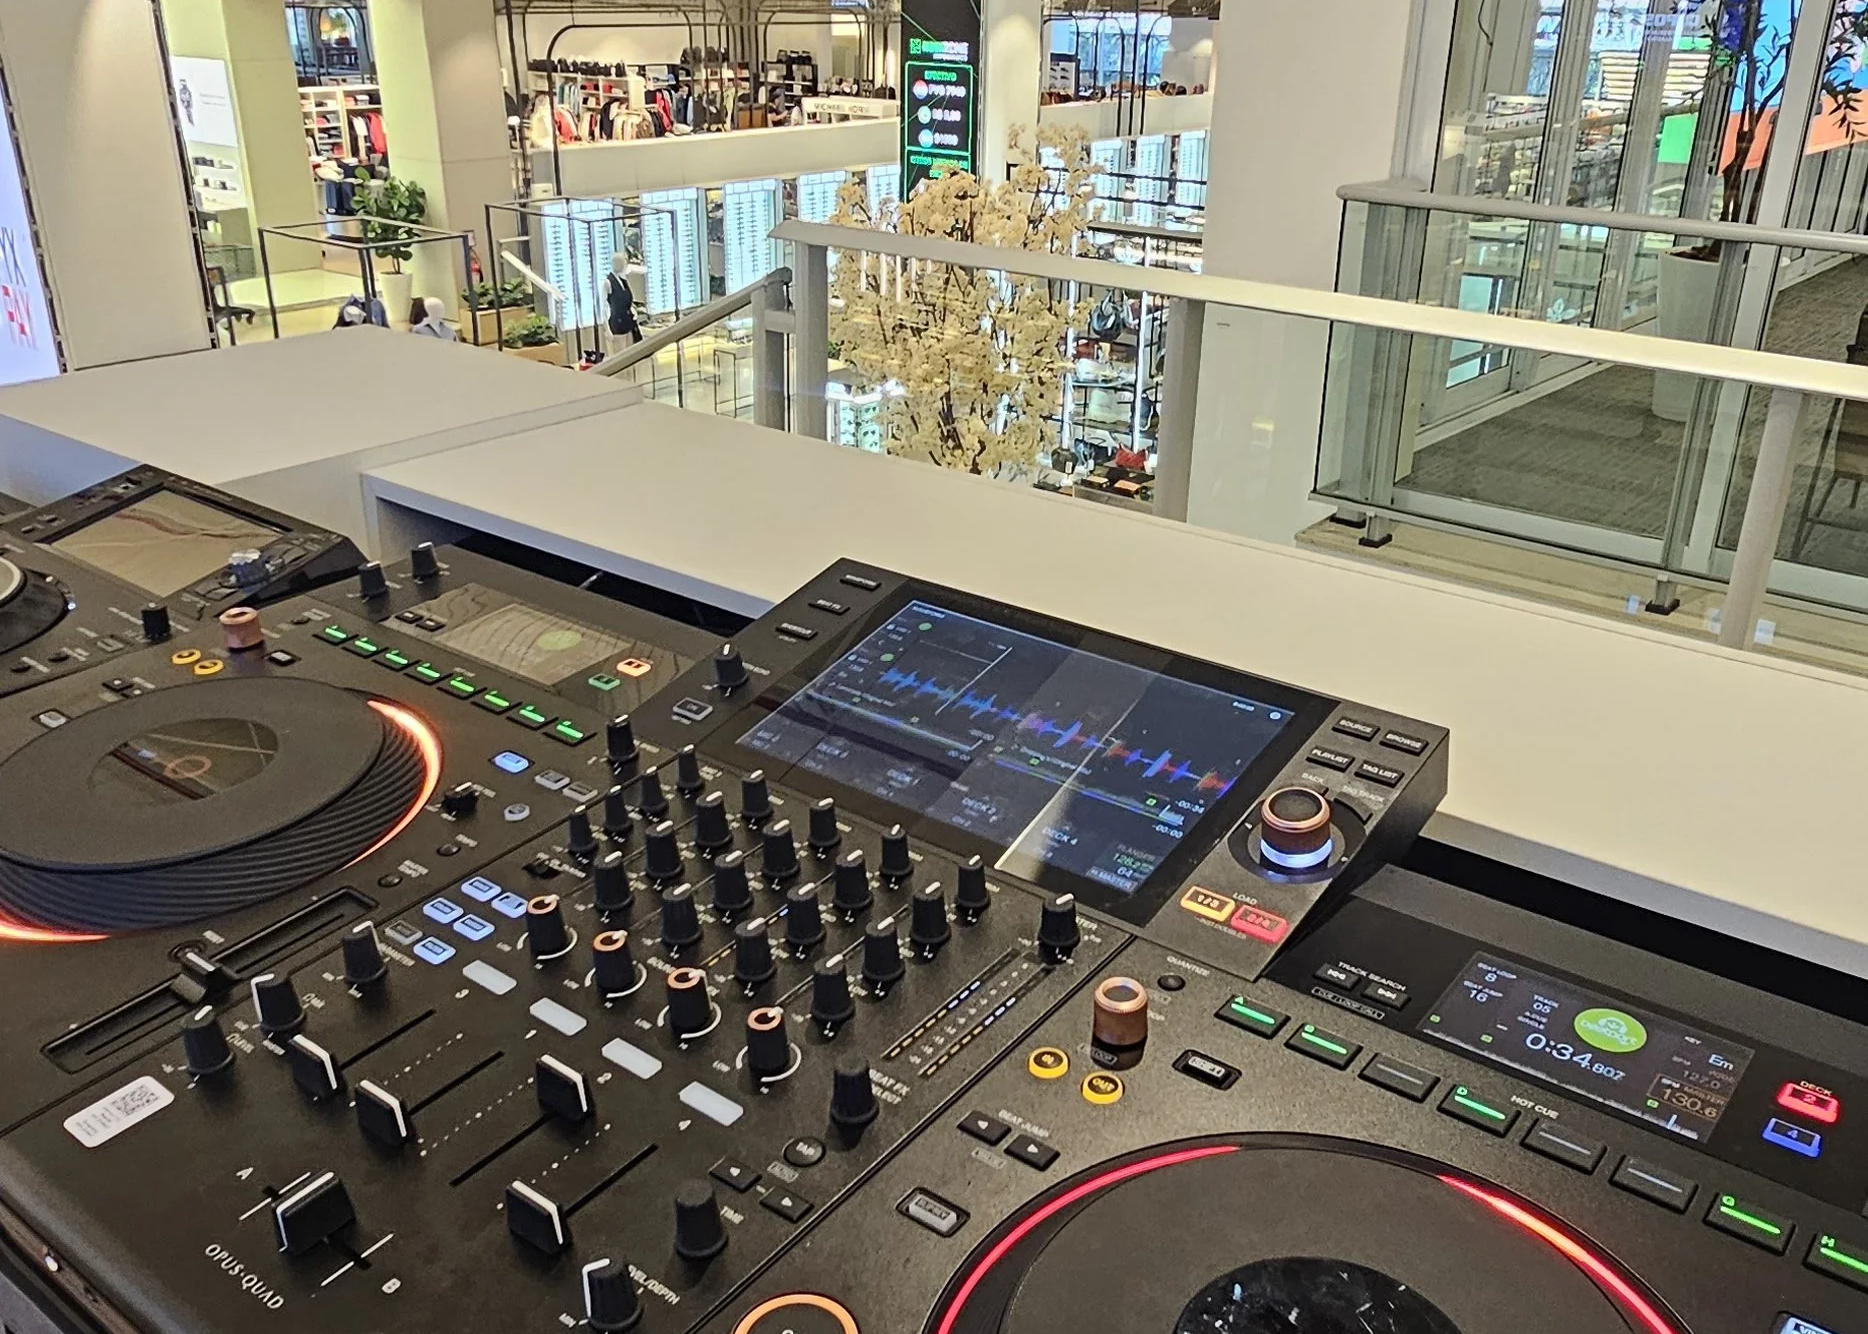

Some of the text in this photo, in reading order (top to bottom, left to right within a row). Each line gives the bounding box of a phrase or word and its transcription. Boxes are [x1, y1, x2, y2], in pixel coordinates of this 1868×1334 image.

[1232, 891, 1258, 905] LOAD
[1167, 955, 1210, 977] QUANTIZE
[1338, 961, 1406, 991] TRACK SEARCH
[1484, 972, 1498, 982] 8
[1470, 989, 1488, 1002] 16
[1533, 1002, 1552, 1013] 05
[1707, 1053, 1734, 1071] Em
[1092, 1078, 1114, 1092] OUT
[1800, 1080, 1832, 1096] DECK
[1662, 1087, 1718, 1118] 130.6
[1803, 1093, 1813, 1104] 2
[1511, 1095, 1560, 1120] HOT CUE
[1787, 1129, 1799, 1139] 4
[236, 1167, 254, 1180] A
[720, 1205, 744, 1224] TIME
[1821, 1235, 1836, 1247] H
[381, 1277, 402, 1294] B
